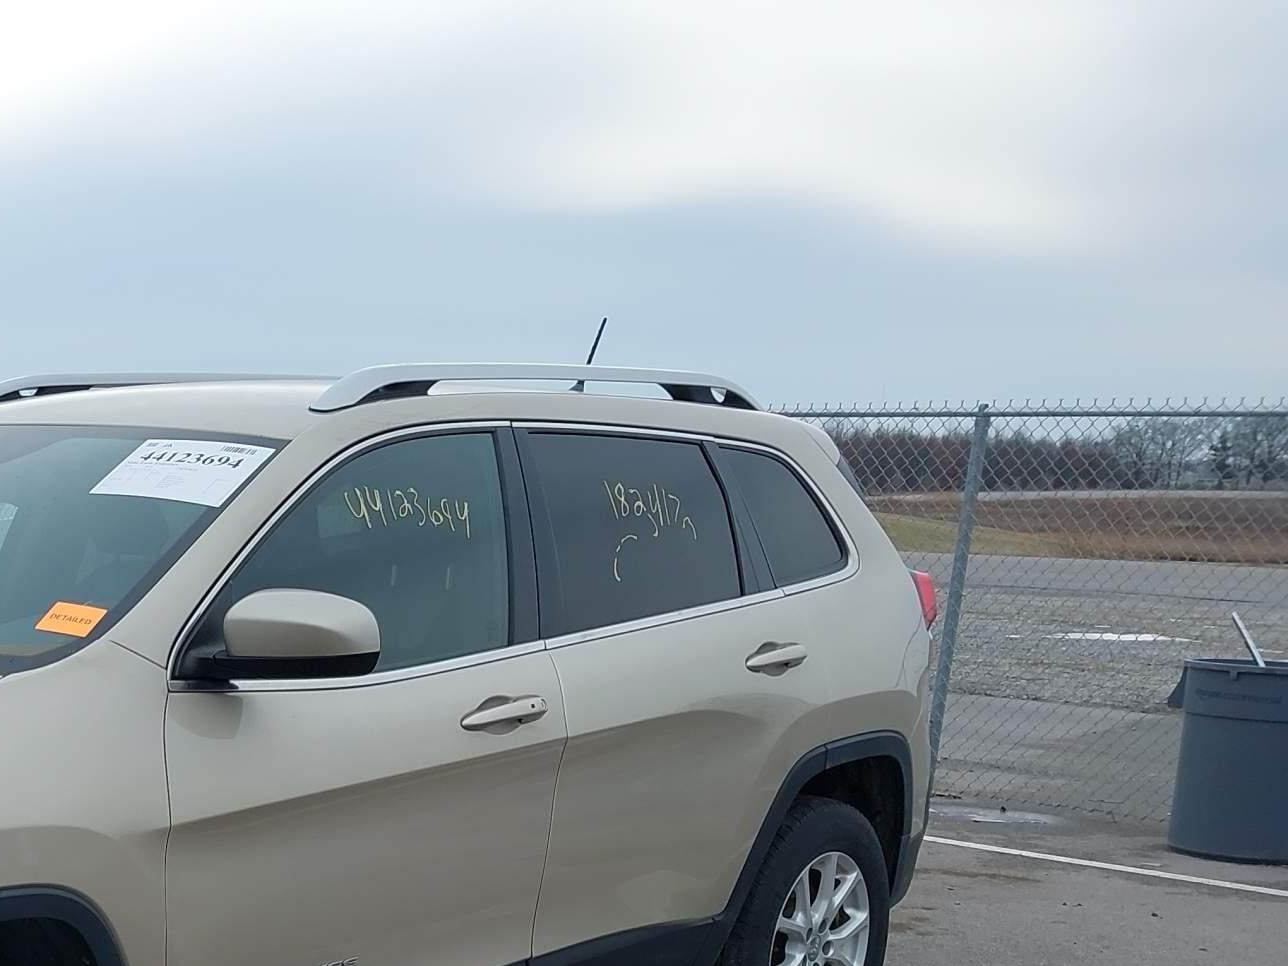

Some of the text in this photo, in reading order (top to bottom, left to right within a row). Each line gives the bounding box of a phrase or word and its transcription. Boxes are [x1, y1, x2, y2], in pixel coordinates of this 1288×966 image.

[140, 451, 245, 469] 44123694
[343, 485, 472, 540] 44123694
[48, 612, 93, 625] DETAILED
